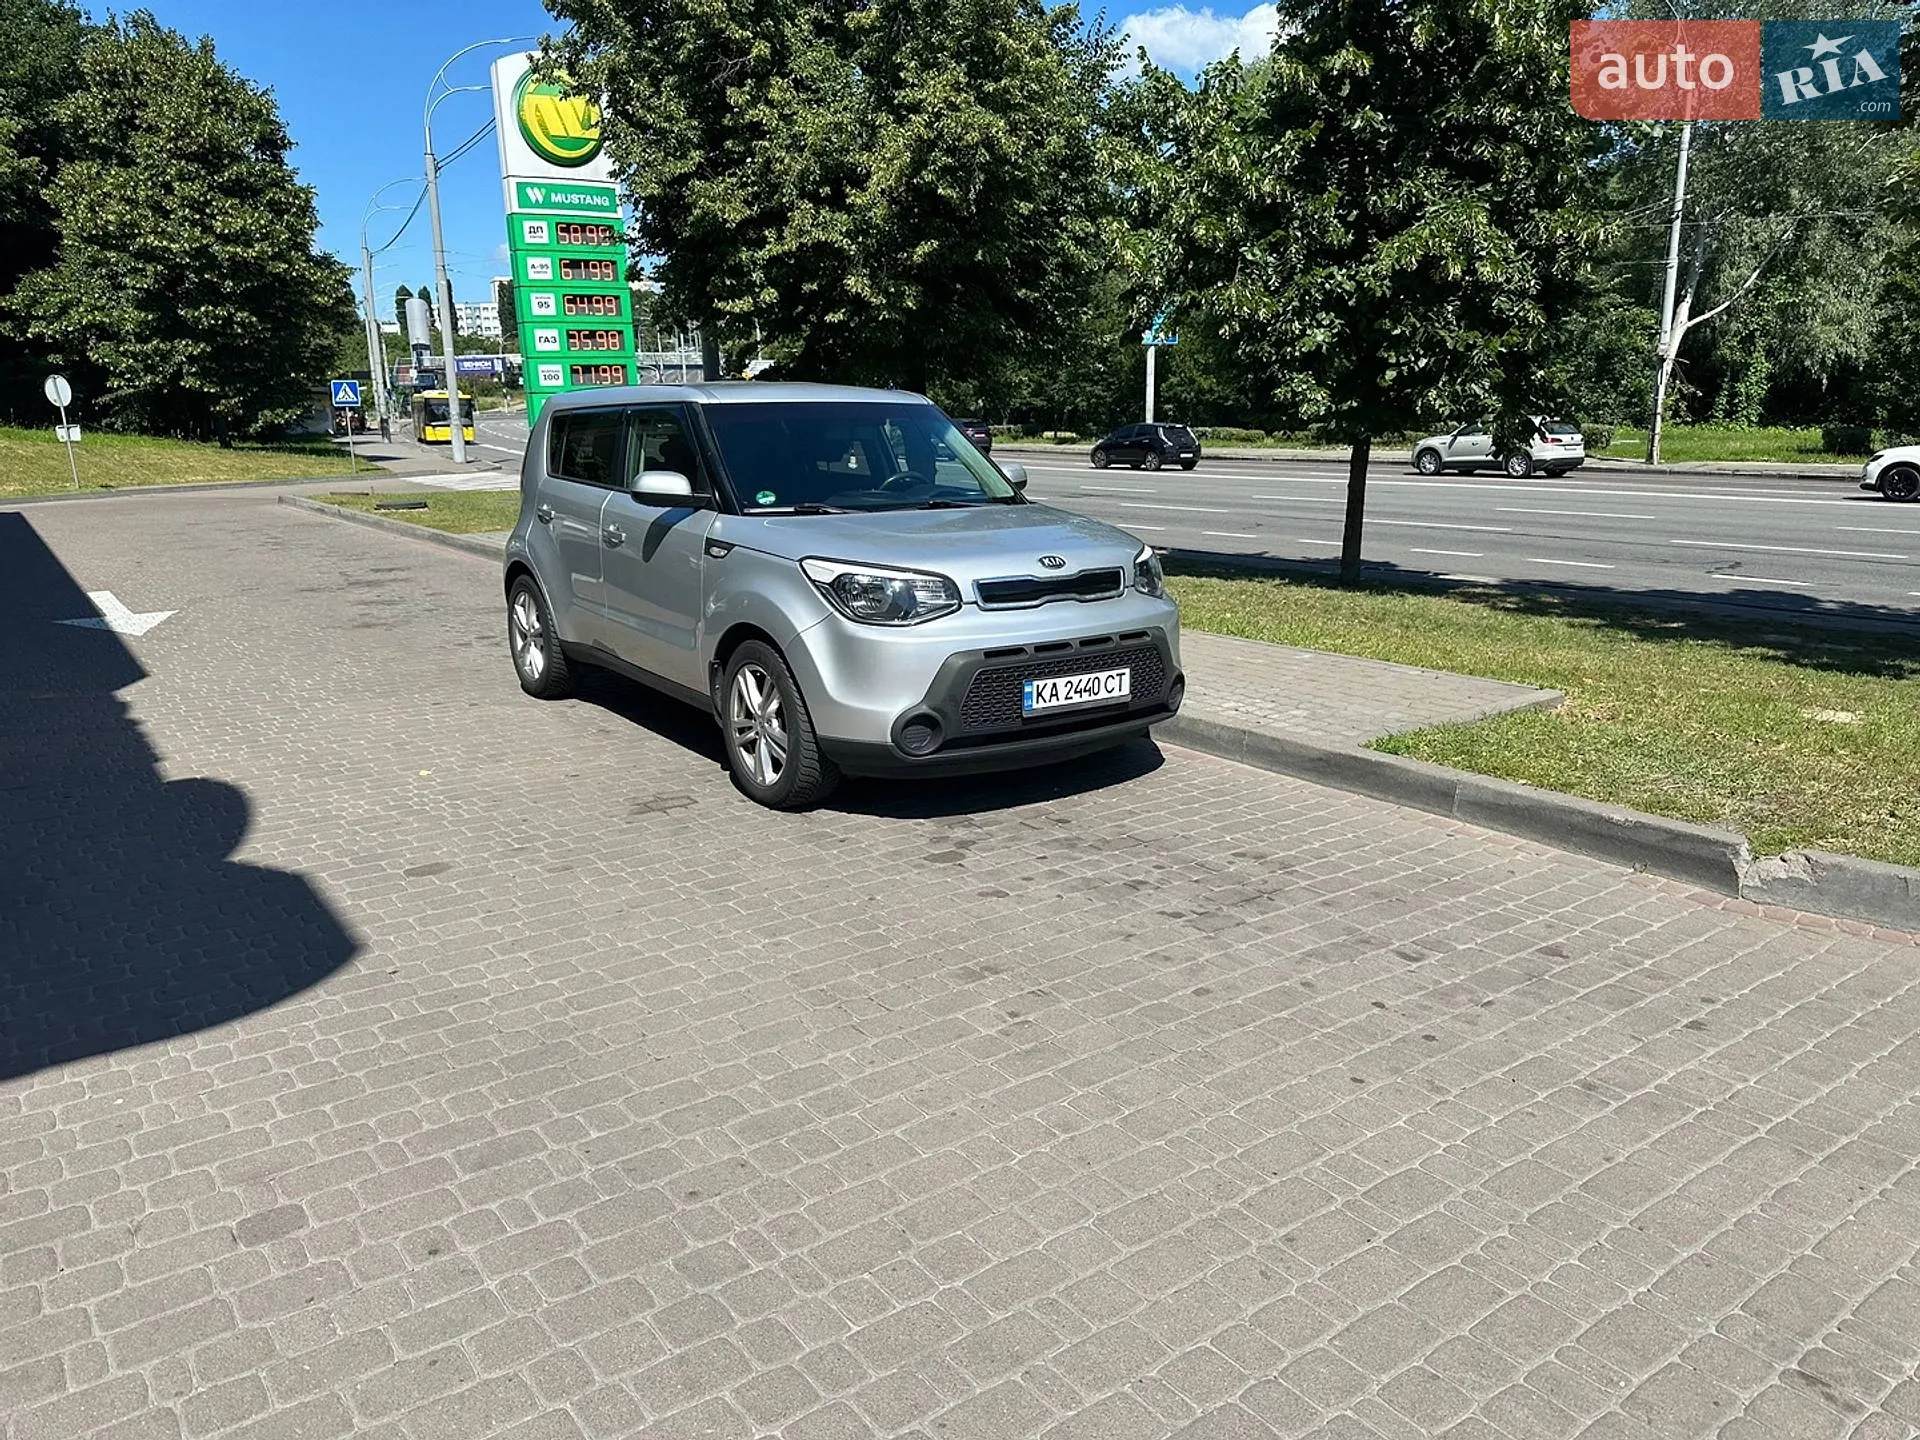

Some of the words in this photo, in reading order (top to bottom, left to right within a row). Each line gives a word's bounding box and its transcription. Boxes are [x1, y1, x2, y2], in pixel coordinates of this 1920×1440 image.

[551, 193, 609, 206] MUSTANG
[537, 301, 550, 309] 95
[564, 296, 616, 316] 64.99
[568, 331, 620, 350] 35.98
[572, 366, 623, 384] 71.99
[1042, 557, 1064, 566] KIA
[1036, 682, 1059, 704] KA
[1064, 677, 1100, 700] 2440
[1104, 672, 1126, 694] CT
